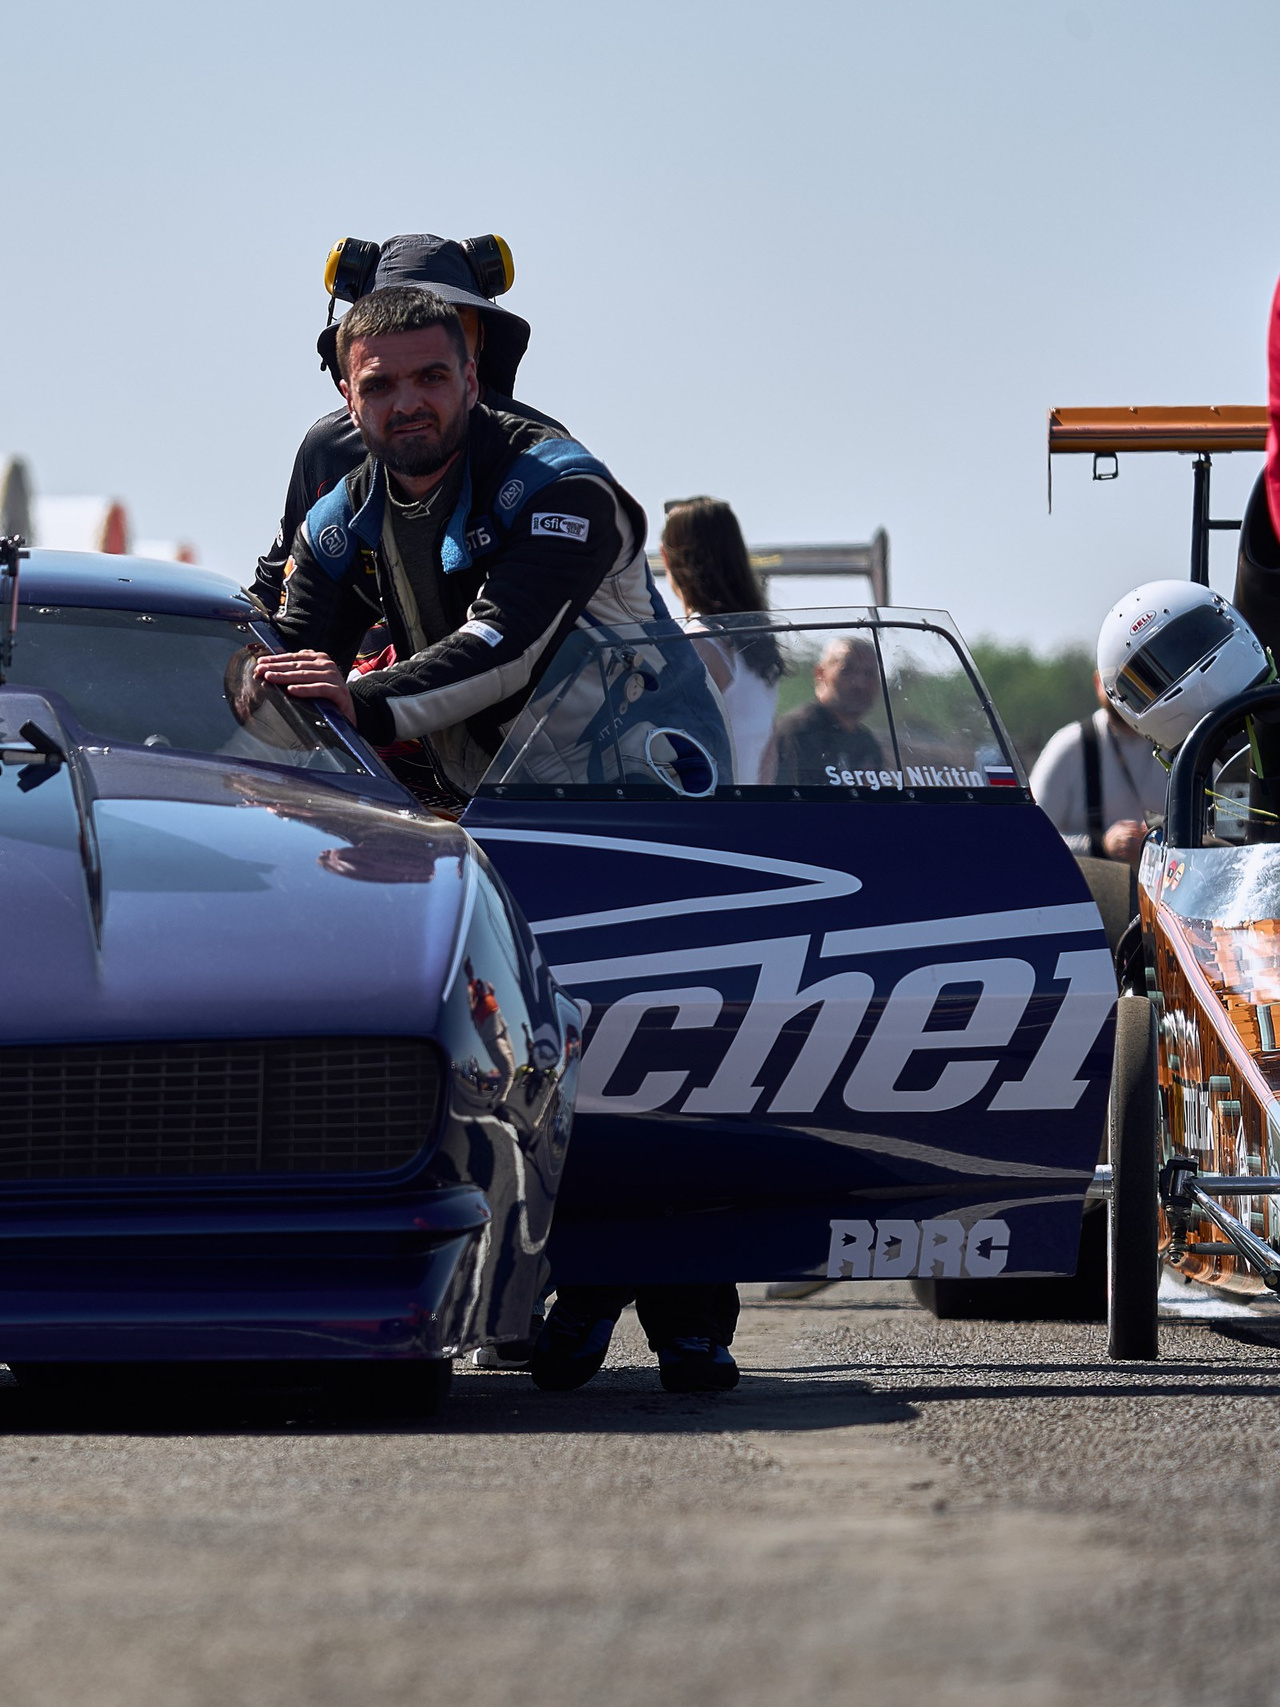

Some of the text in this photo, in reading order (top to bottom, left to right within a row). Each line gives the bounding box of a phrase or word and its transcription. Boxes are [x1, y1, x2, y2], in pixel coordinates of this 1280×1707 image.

[544, 517, 559, 530] sfi
[1132, 613, 1153, 632] BELL
[825, 765, 985, 791] Sergey Nikitin
[826, 1219, 1011, 1278] RDRC
